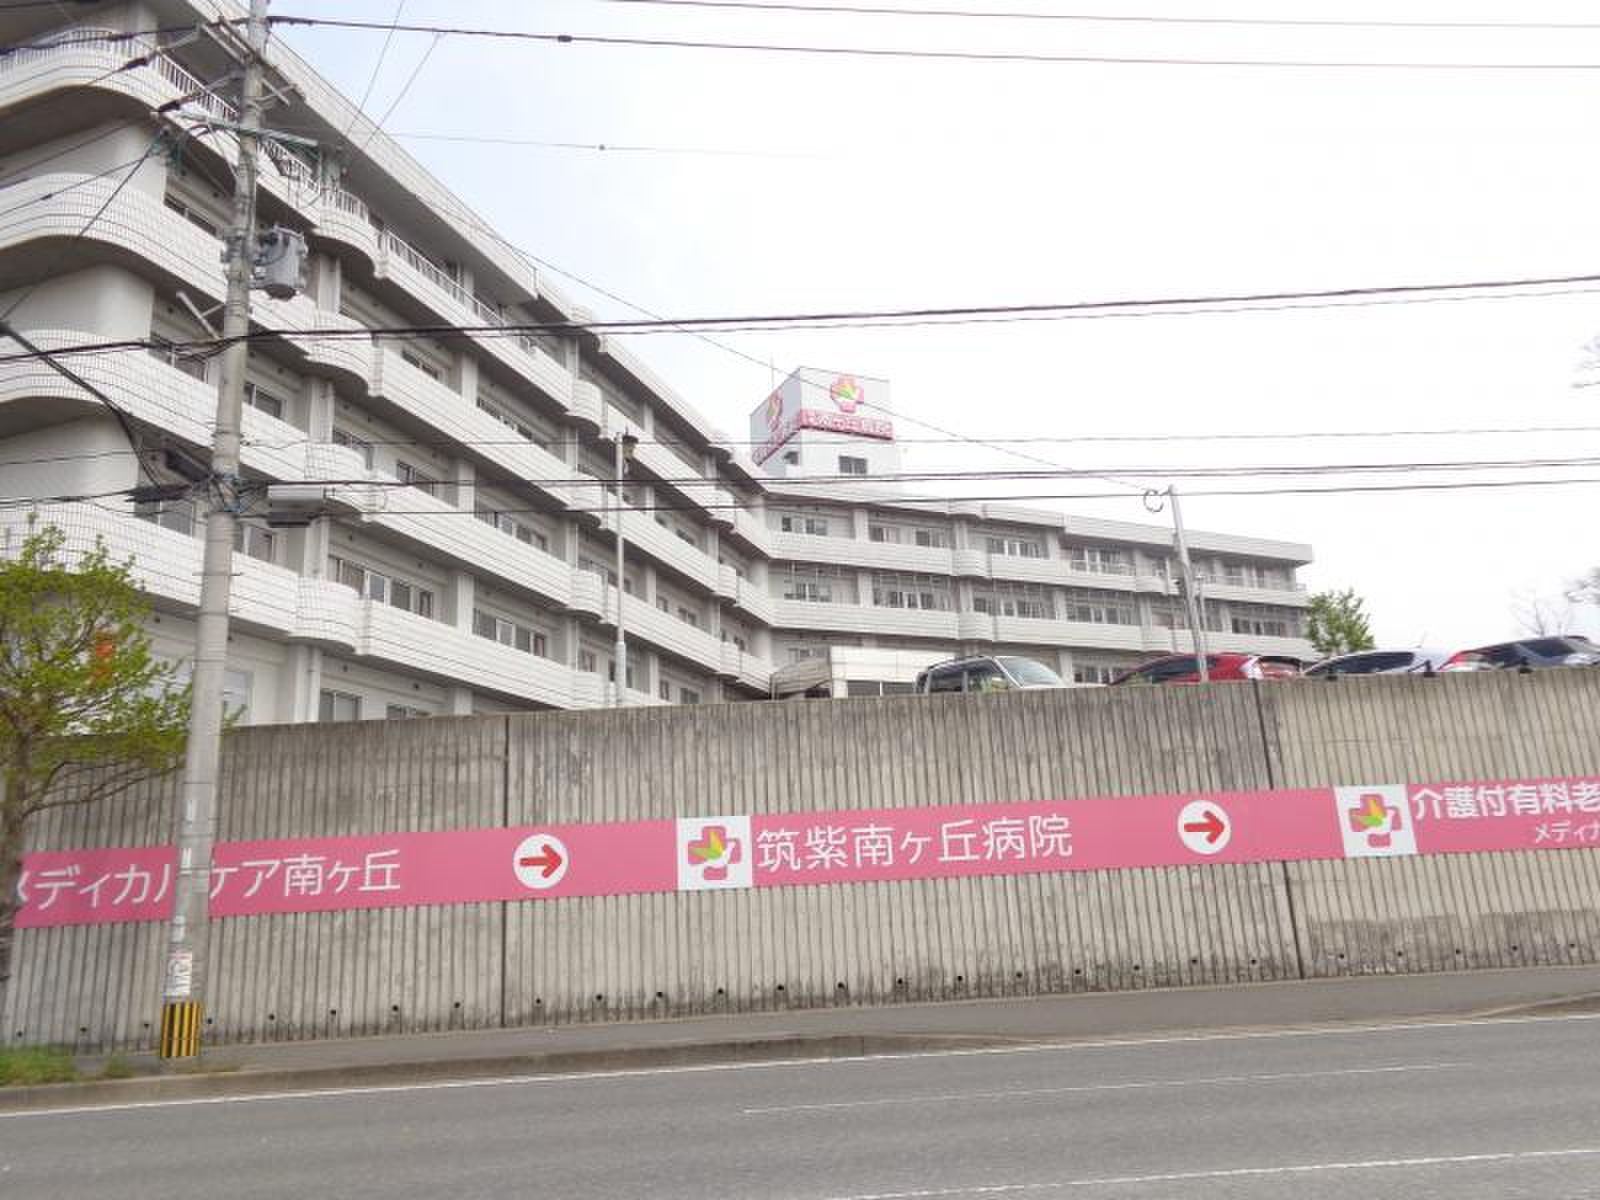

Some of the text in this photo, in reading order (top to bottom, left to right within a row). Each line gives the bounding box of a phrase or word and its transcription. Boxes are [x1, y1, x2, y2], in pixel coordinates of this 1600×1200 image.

[1413, 782, 1600, 819] 介護付有料老
[756, 813, 1073, 871] 筑紫南ヶ丘病院
